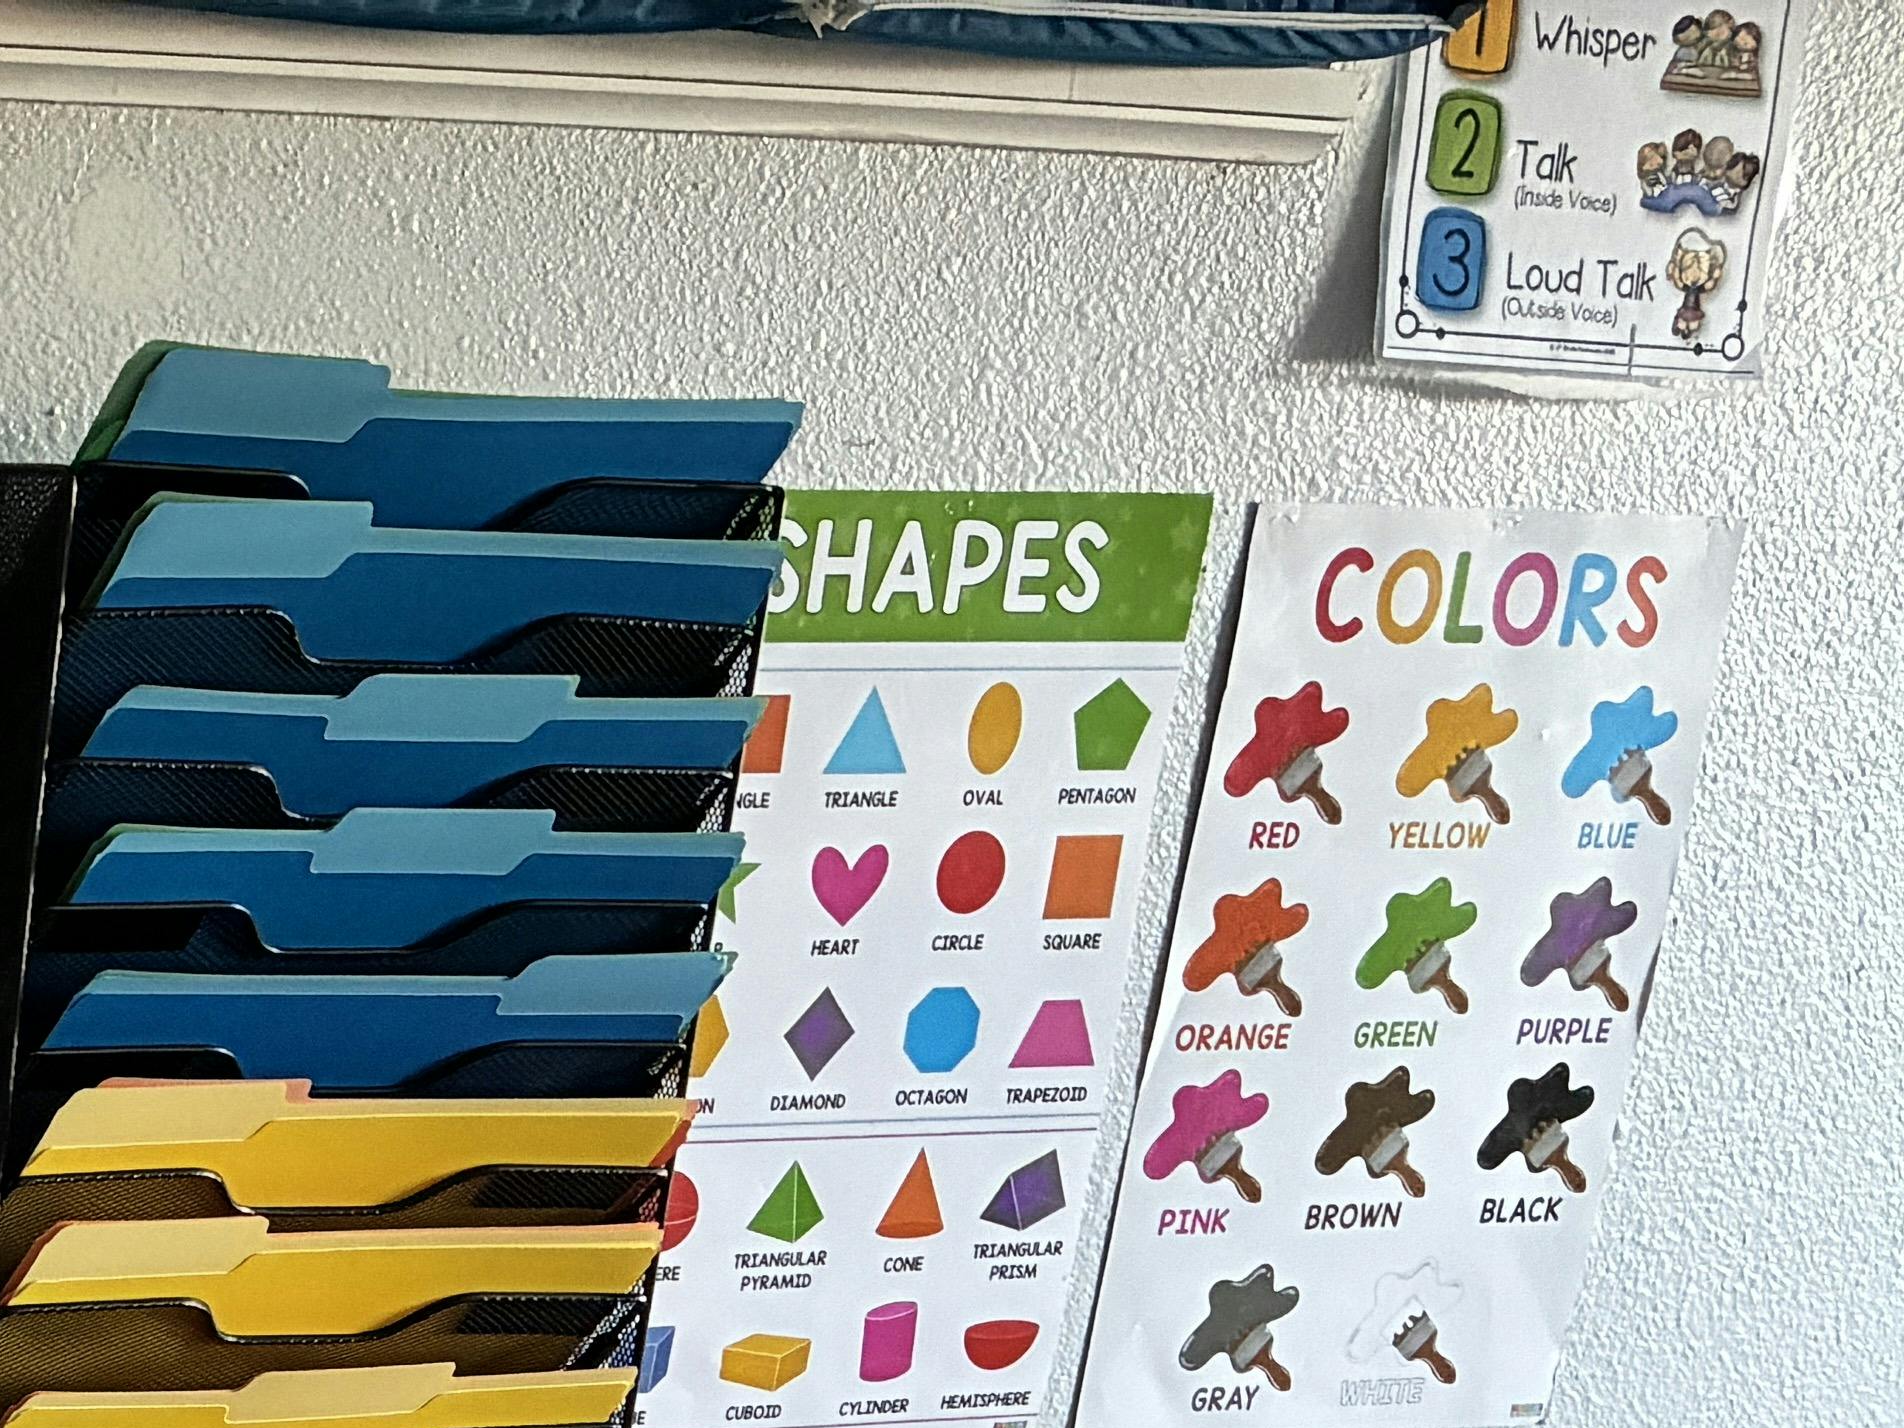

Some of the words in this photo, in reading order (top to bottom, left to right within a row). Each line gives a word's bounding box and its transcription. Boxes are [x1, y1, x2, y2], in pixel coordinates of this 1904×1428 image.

[1535, 12, 1658, 70] Whisper
[1451, 107, 1480, 180] 2
[1516, 138, 1579, 184] Talk
[1514, 185, 1564, 210] (Inside
[1569, 190, 1618, 214] Voice)
[1431, 227, 1472, 297] 3
[1505, 251, 1584, 296] Loud
[1596, 258, 1658, 303] Talk
[1501, 295, 1567, 323] (Outside
[1569, 302, 1619, 327] Voice)
[768, 518, 1110, 615] SHAPES
[1314, 546, 1669, 648] COLORS
[824, 789, 899, 809] TRIANGLE
[963, 789, 1004, 807] OVAL
[1058, 787, 1137, 805] PENTAGON
[1248, 821, 1301, 851] RED
[1388, 821, 1493, 851] YELLOW
[1576, 821, 1639, 850] BLUE
[811, 939, 860, 956] HEART
[931, 935, 984, 953] CIRCLE
[1043, 934, 1102, 950] SQUARE
[1174, 1022, 1293, 1053] ORANGE
[1353, 1019, 1440, 1050] GREEN
[1515, 1017, 1614, 1047] PURPLE
[769, 1094, 846, 1111] DIAMOND
[895, 1089, 969, 1106] OCTAGON
[1005, 1087, 1088, 1104] TRAPEZOID
[1157, 1206, 1231, 1237] PINK
[1303, 1200, 1403, 1232] BROWN
[1478, 1197, 1564, 1225] BLACK
[734, 1251, 827, 1270] TRIANGULAR
[883, 1255, 925, 1273] CONE
[973, 1241, 1063, 1259] TRIANGULAR
[740, 1273, 812, 1292] PYRAMID
[989, 1264, 1037, 1281] PRISM
[726, 1404, 782, 1421] CUBOID
[839, 1398, 909, 1417] CYLINDER
[940, 1390, 1031, 1410] HEMISPHERE
[1191, 1384, 1261, 1413] GRAY
[1339, 1377, 1427, 1407] WHITE
